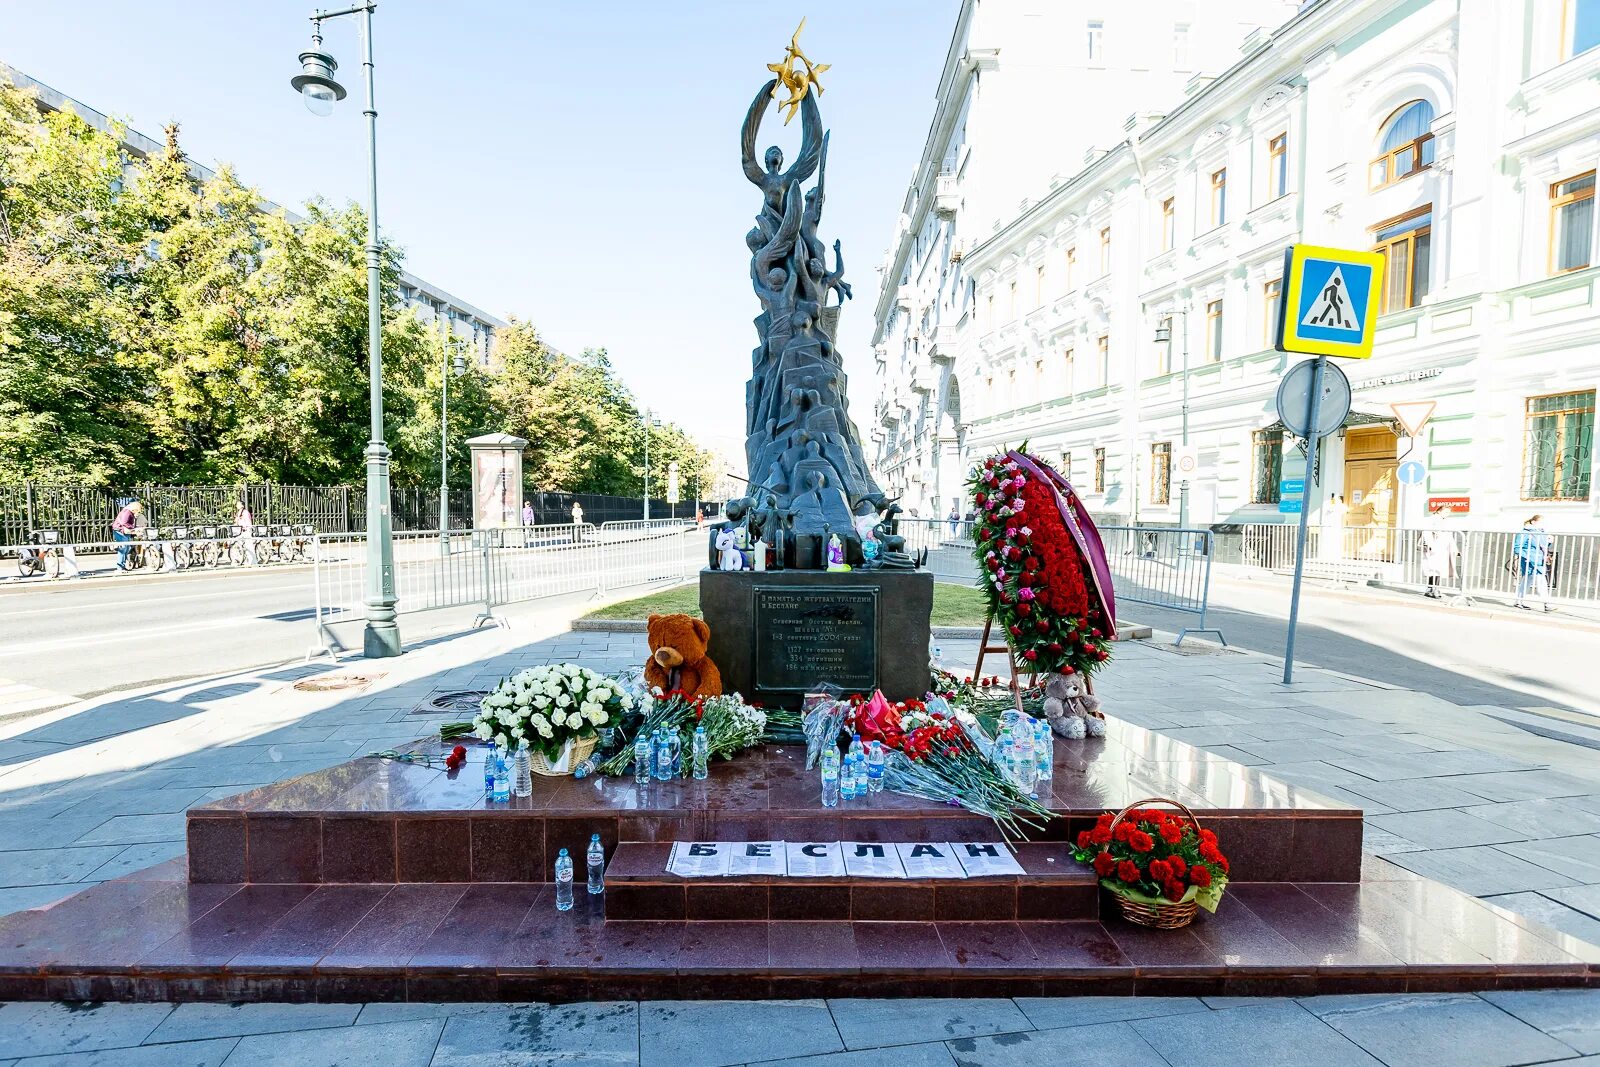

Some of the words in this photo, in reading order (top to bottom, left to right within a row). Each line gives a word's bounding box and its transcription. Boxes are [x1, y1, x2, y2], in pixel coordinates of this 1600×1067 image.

[819, 633, 840, 641] 2004
[789, 654, 803, 662] 334
[688, 843, 1000, 858] БЕСЛАН
